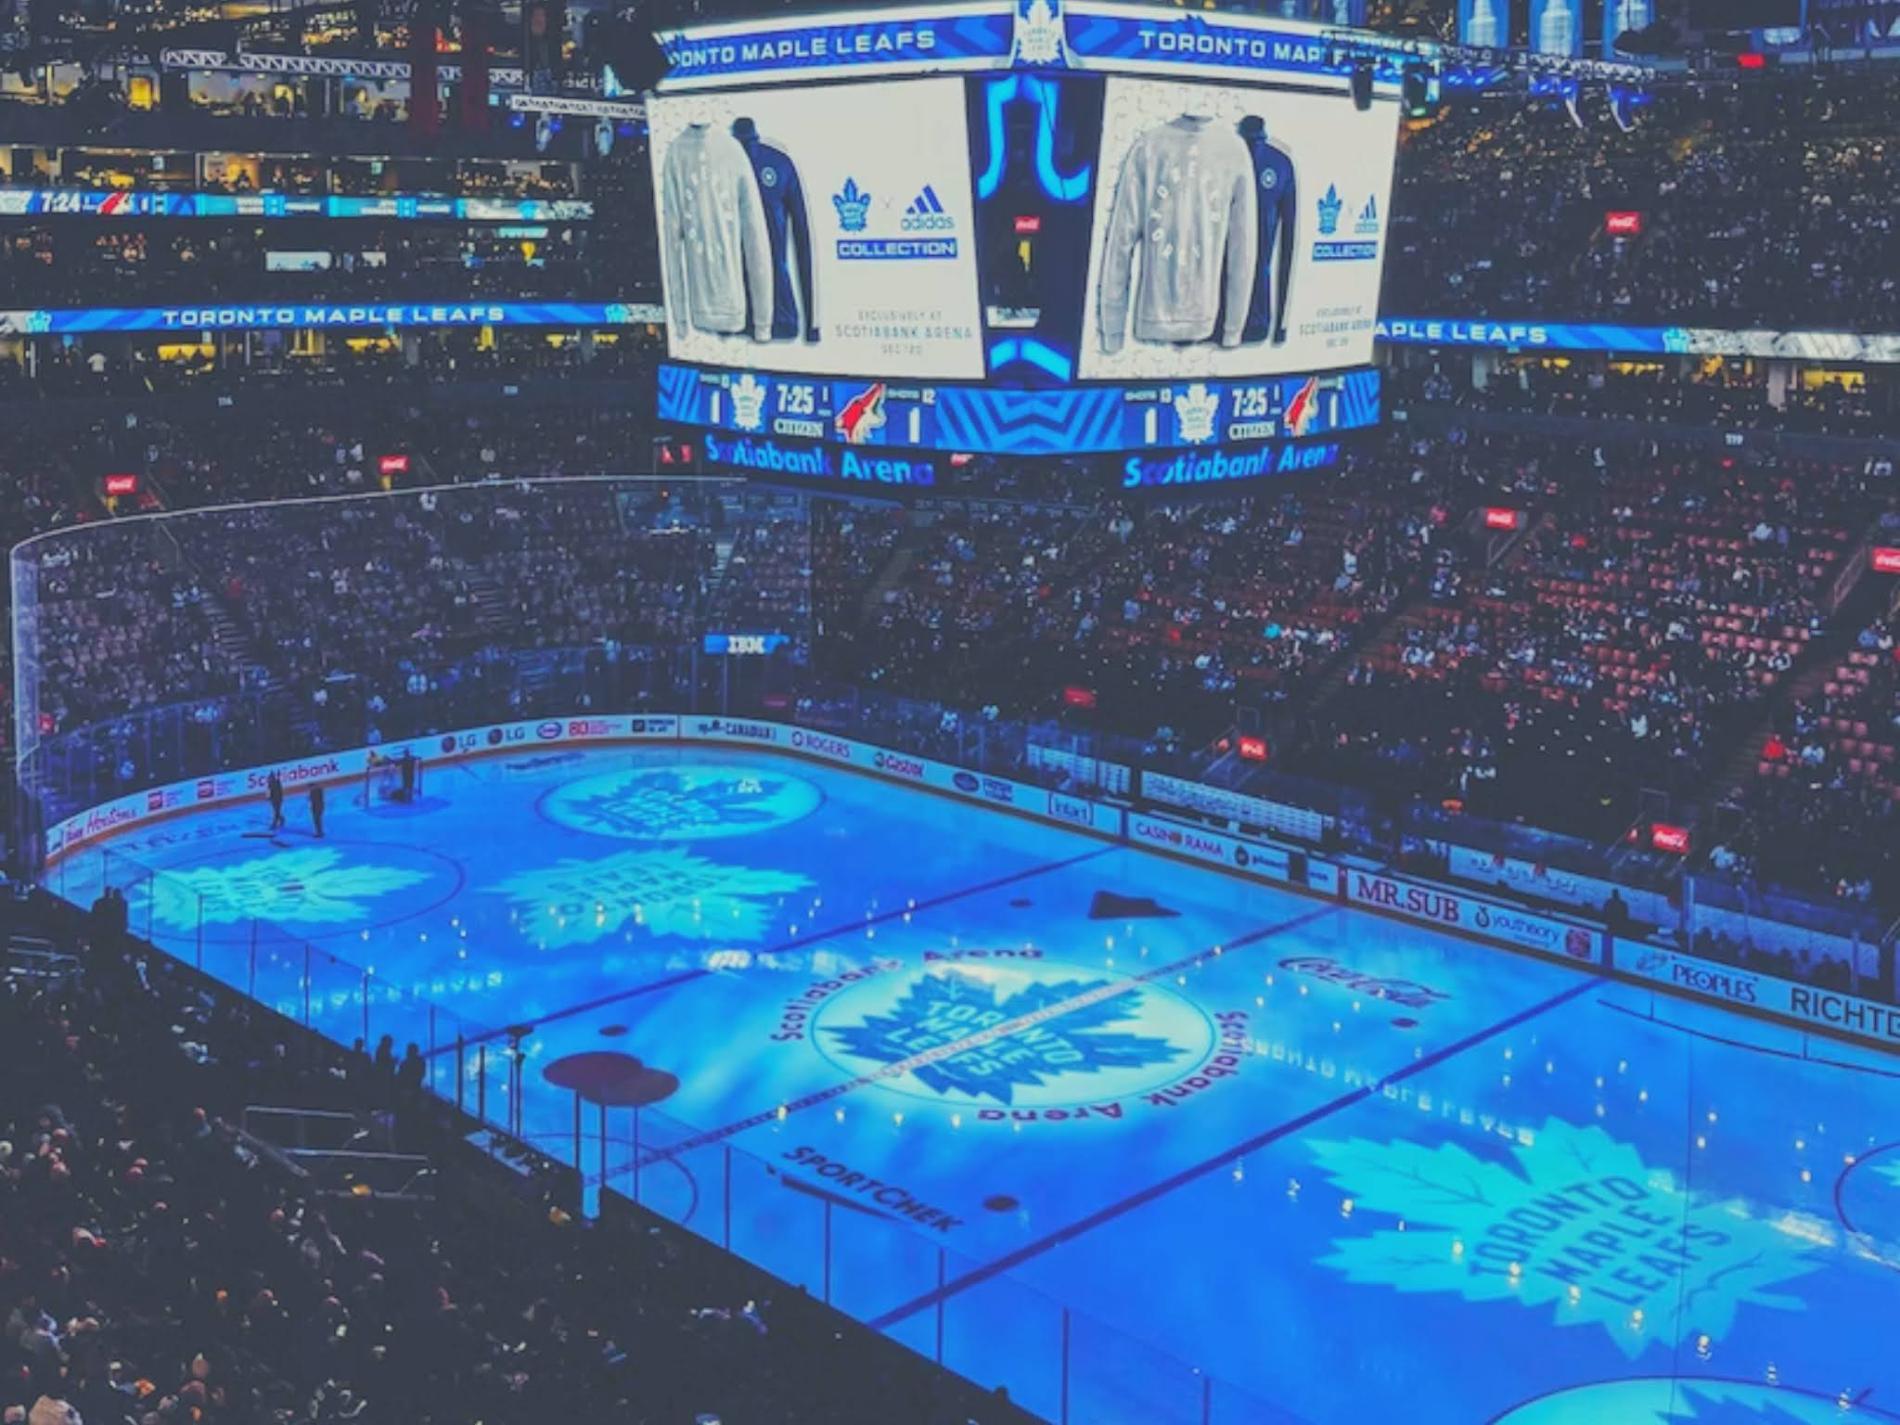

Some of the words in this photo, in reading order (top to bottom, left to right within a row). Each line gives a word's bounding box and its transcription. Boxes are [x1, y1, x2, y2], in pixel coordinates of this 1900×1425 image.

[742, 37, 826, 62] MAPLE
[836, 29, 937, 53] LEAFS
[1137, 30, 1266, 58] TORONTO
[41, 192, 80, 213] 7:24
[900, 215, 955, 231] adidas
[838, 240, 955, 258] COLLECTION
[164, 308, 295, 326] TORONTO
[305, 306, 403, 324] MAPLE
[413, 305, 506, 323] LEAFS
[835, 325, 918, 339] SCOTIABANK
[926, 325, 973, 339] ARENA
[1375, 321, 1442, 340] APLE
[1452, 323, 1548, 344] LEAFS
[776, 383, 815, 416] 7:25
[1231, 386, 1269, 418] 7:25
[705, 433, 833, 476] Scotiabank
[841, 450, 936, 486] Arena
[1122, 445, 1276, 489] Scotiabank
[1277, 443, 1342, 473] Arena
[458, 733, 478, 749] LG
[505, 726, 526, 742] LG
[922, 947, 1044, 963] Arena
[1671, 962, 1757, 1004] PEOPLES
[977, 1101, 1123, 1122] Arena
[1467, 1174, 1651, 1278] TORONTO
[1534, 1202, 1674, 1284] MAPLE
[1588, 1222, 1732, 1306] LEAFS
